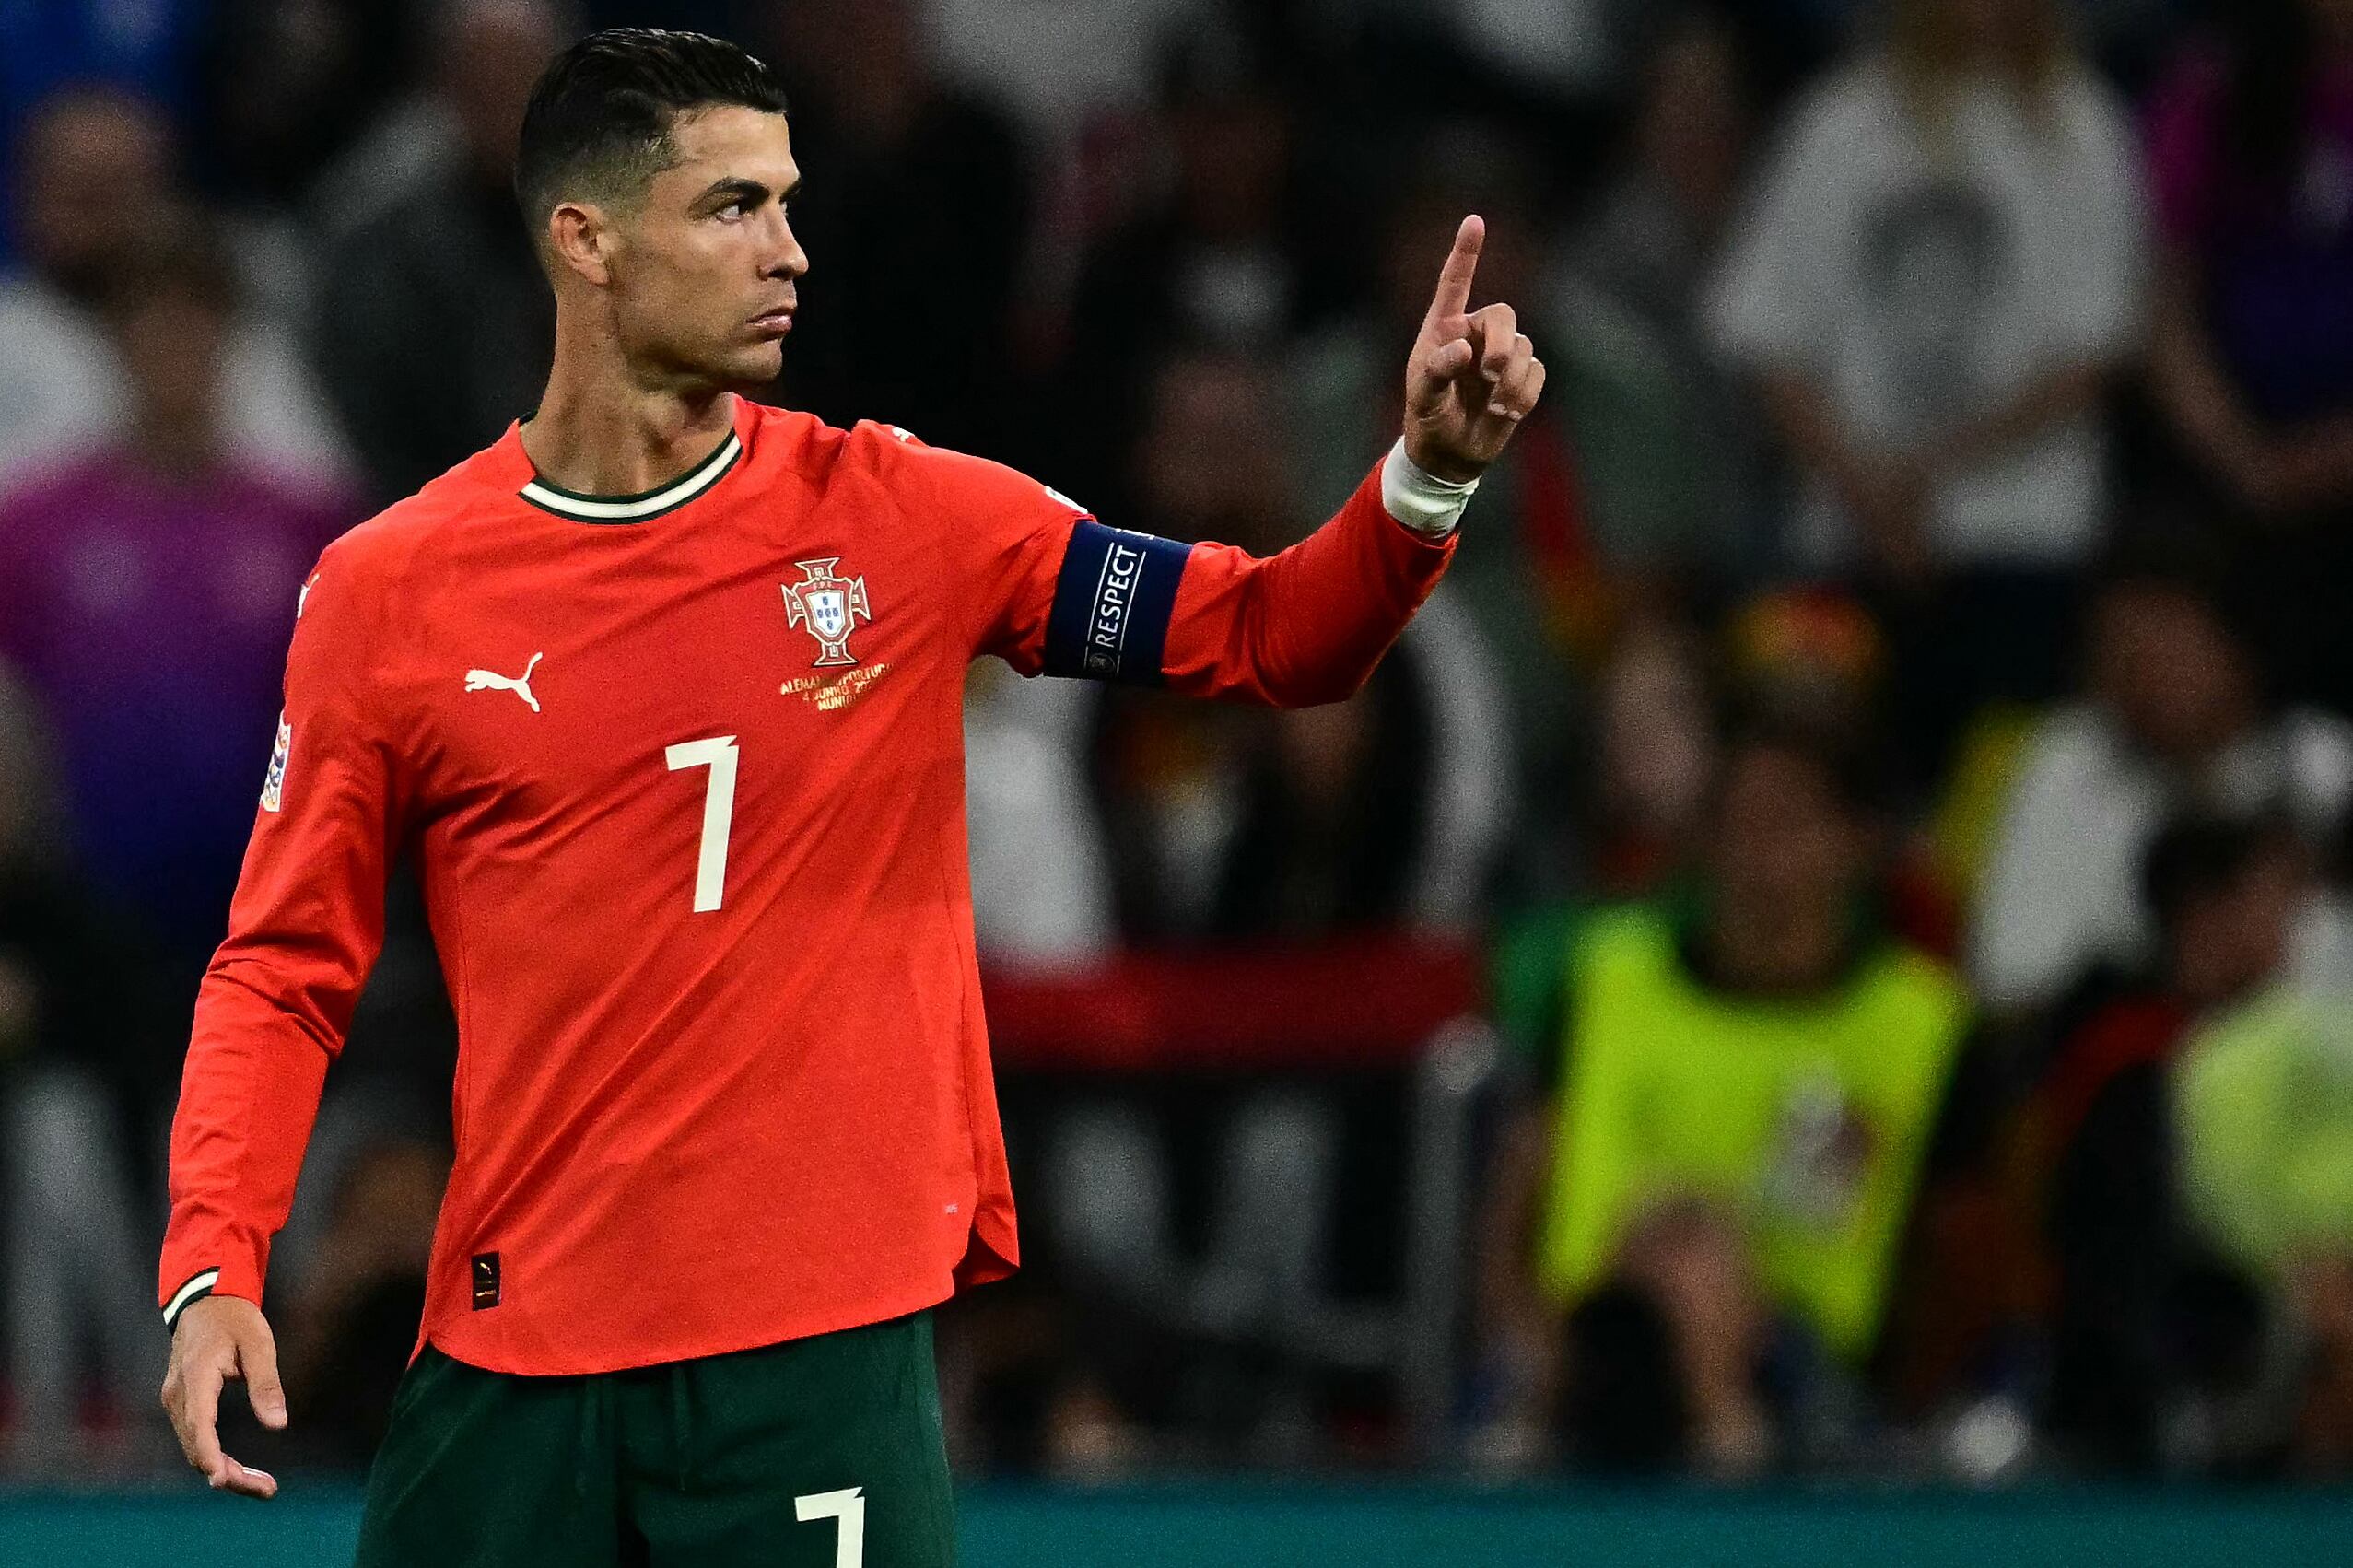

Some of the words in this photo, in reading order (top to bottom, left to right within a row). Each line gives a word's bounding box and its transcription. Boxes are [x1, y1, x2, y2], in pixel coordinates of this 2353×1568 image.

[1095, 544, 1138, 649] RESPECT
[814, 685, 849, 701] JUNHO
[665, 735, 740, 913] 7
[794, 1486, 865, 1568] 7
